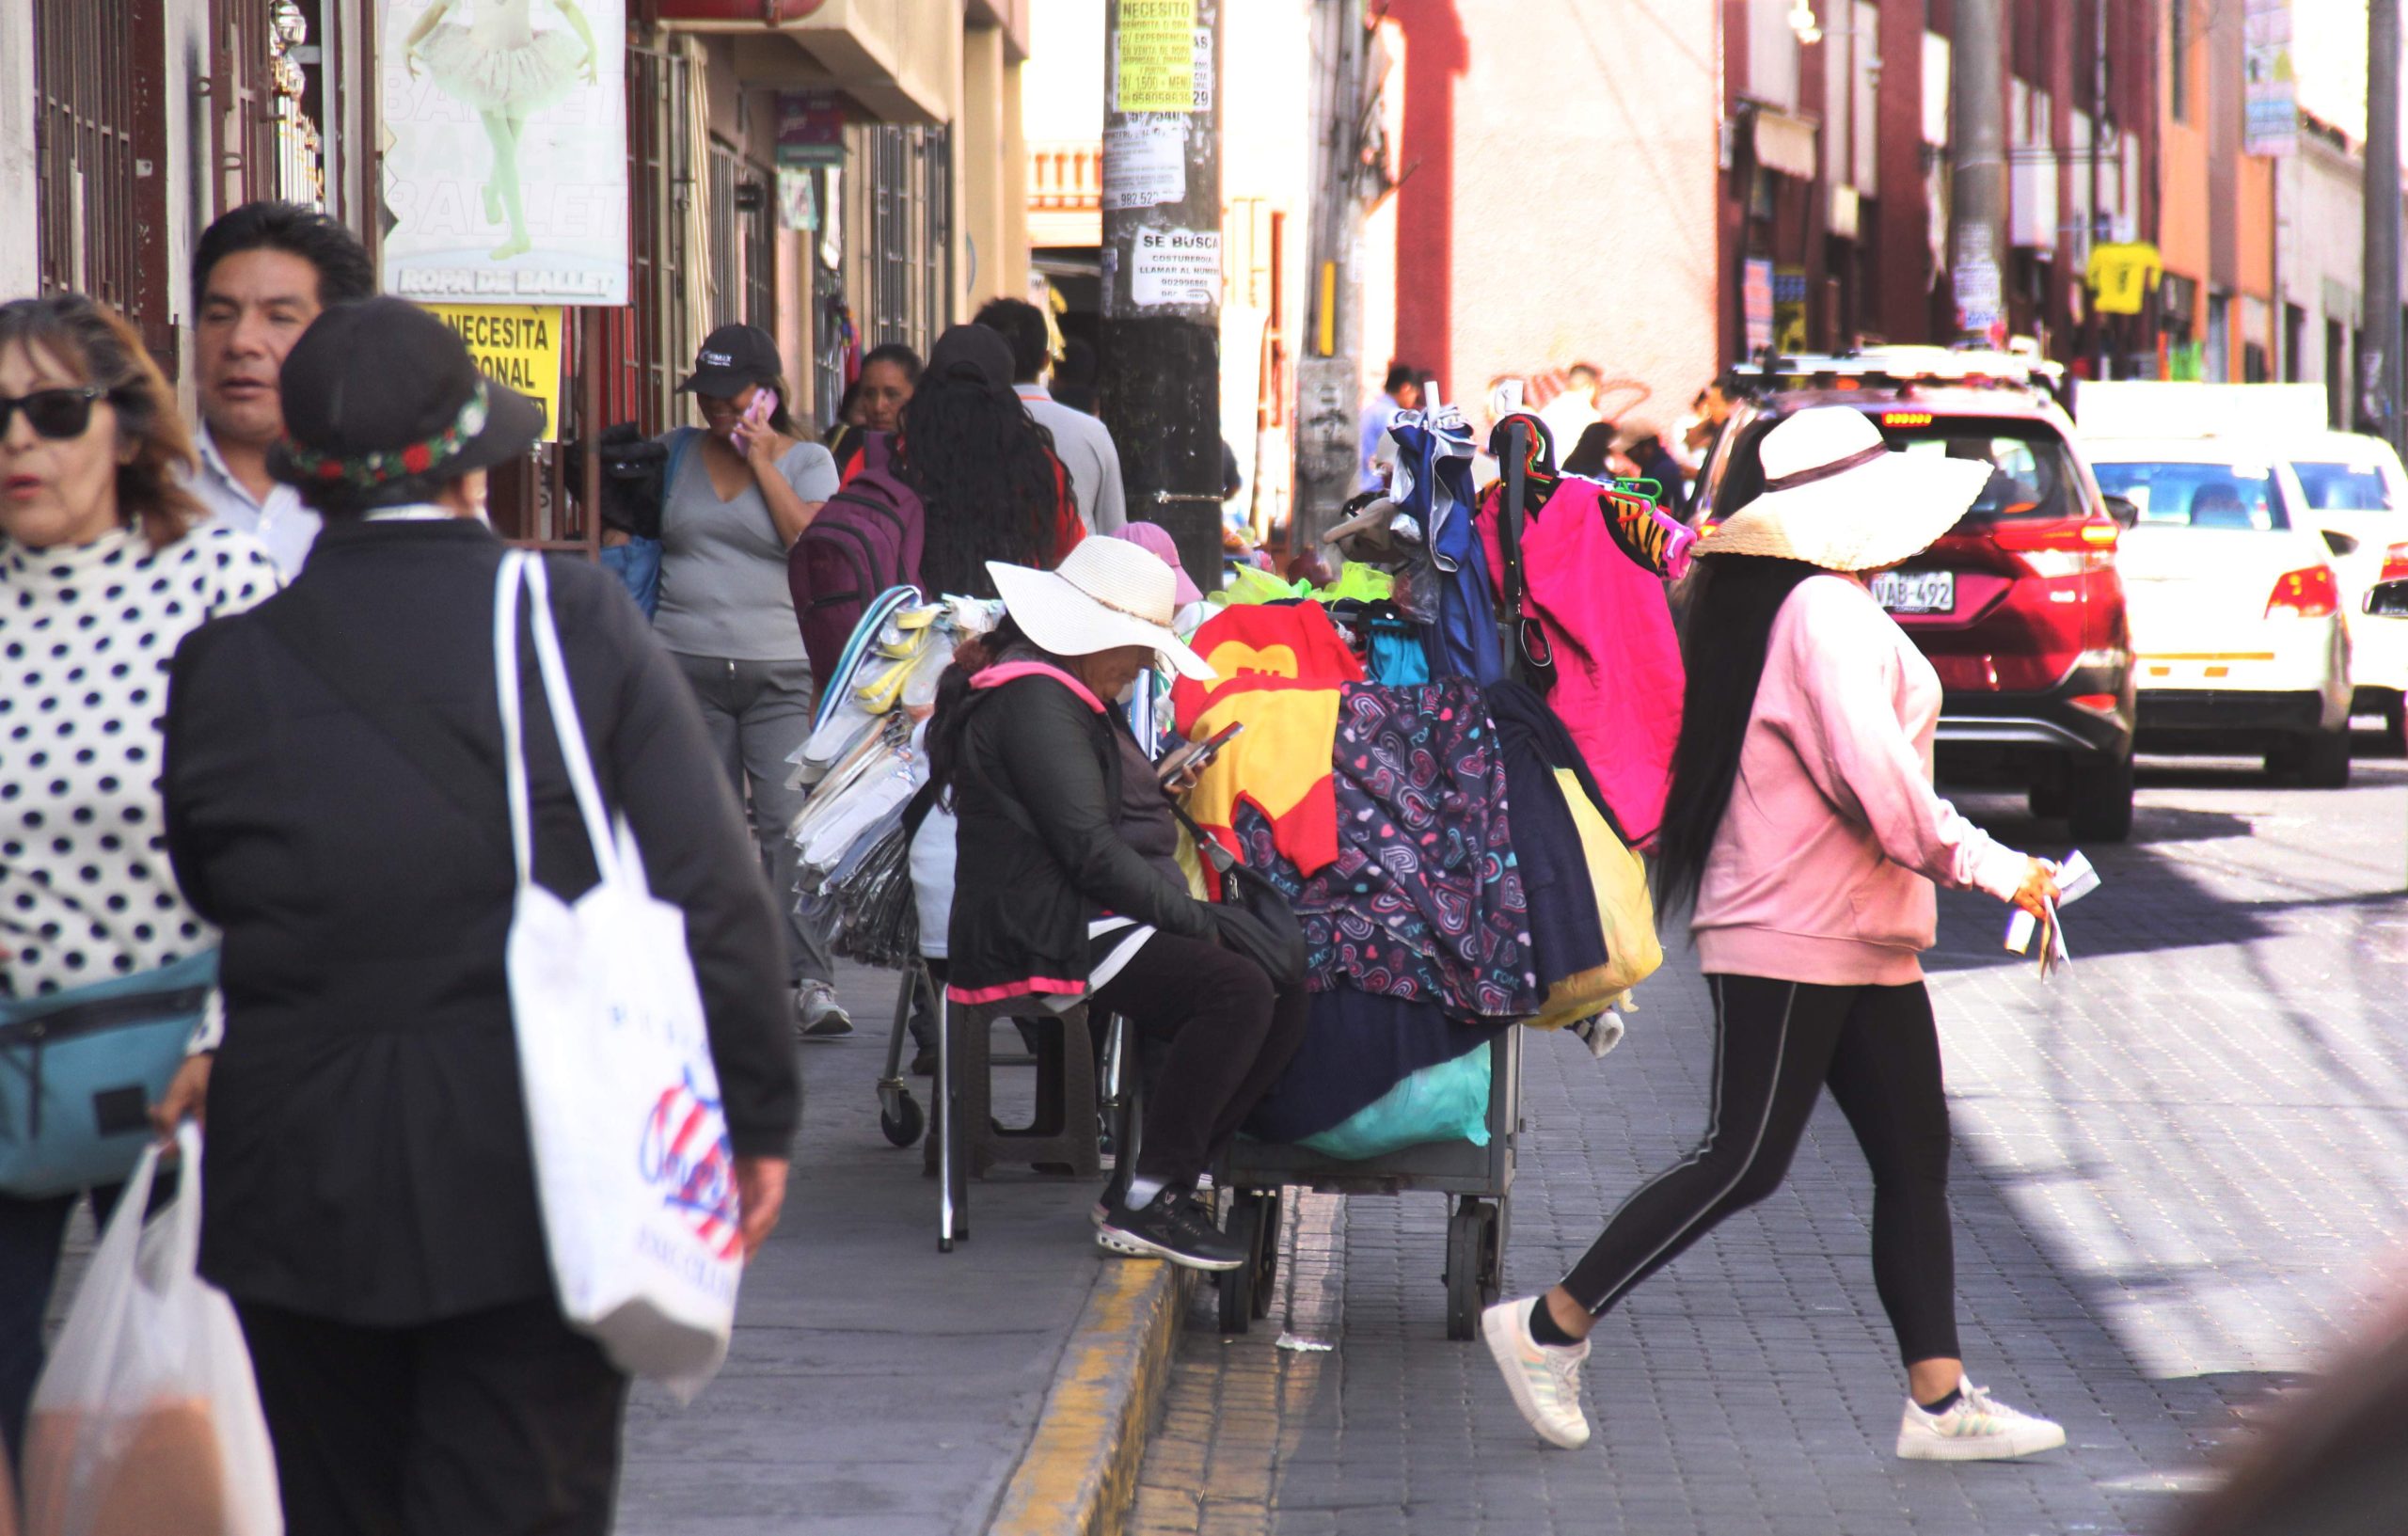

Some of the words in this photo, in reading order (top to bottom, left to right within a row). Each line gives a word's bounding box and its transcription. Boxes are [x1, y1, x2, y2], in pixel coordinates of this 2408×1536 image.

[1122, 2, 1190, 18] NECESITO
[1143, 235, 1165, 248] SE
[1172, 236, 1219, 249] BUSCA
[1139, 266, 1178, 275] LLAMAR
[398, 268, 473, 296] ROPA
[474, 269, 512, 296] DE
[514, 269, 614, 298] BALLET
